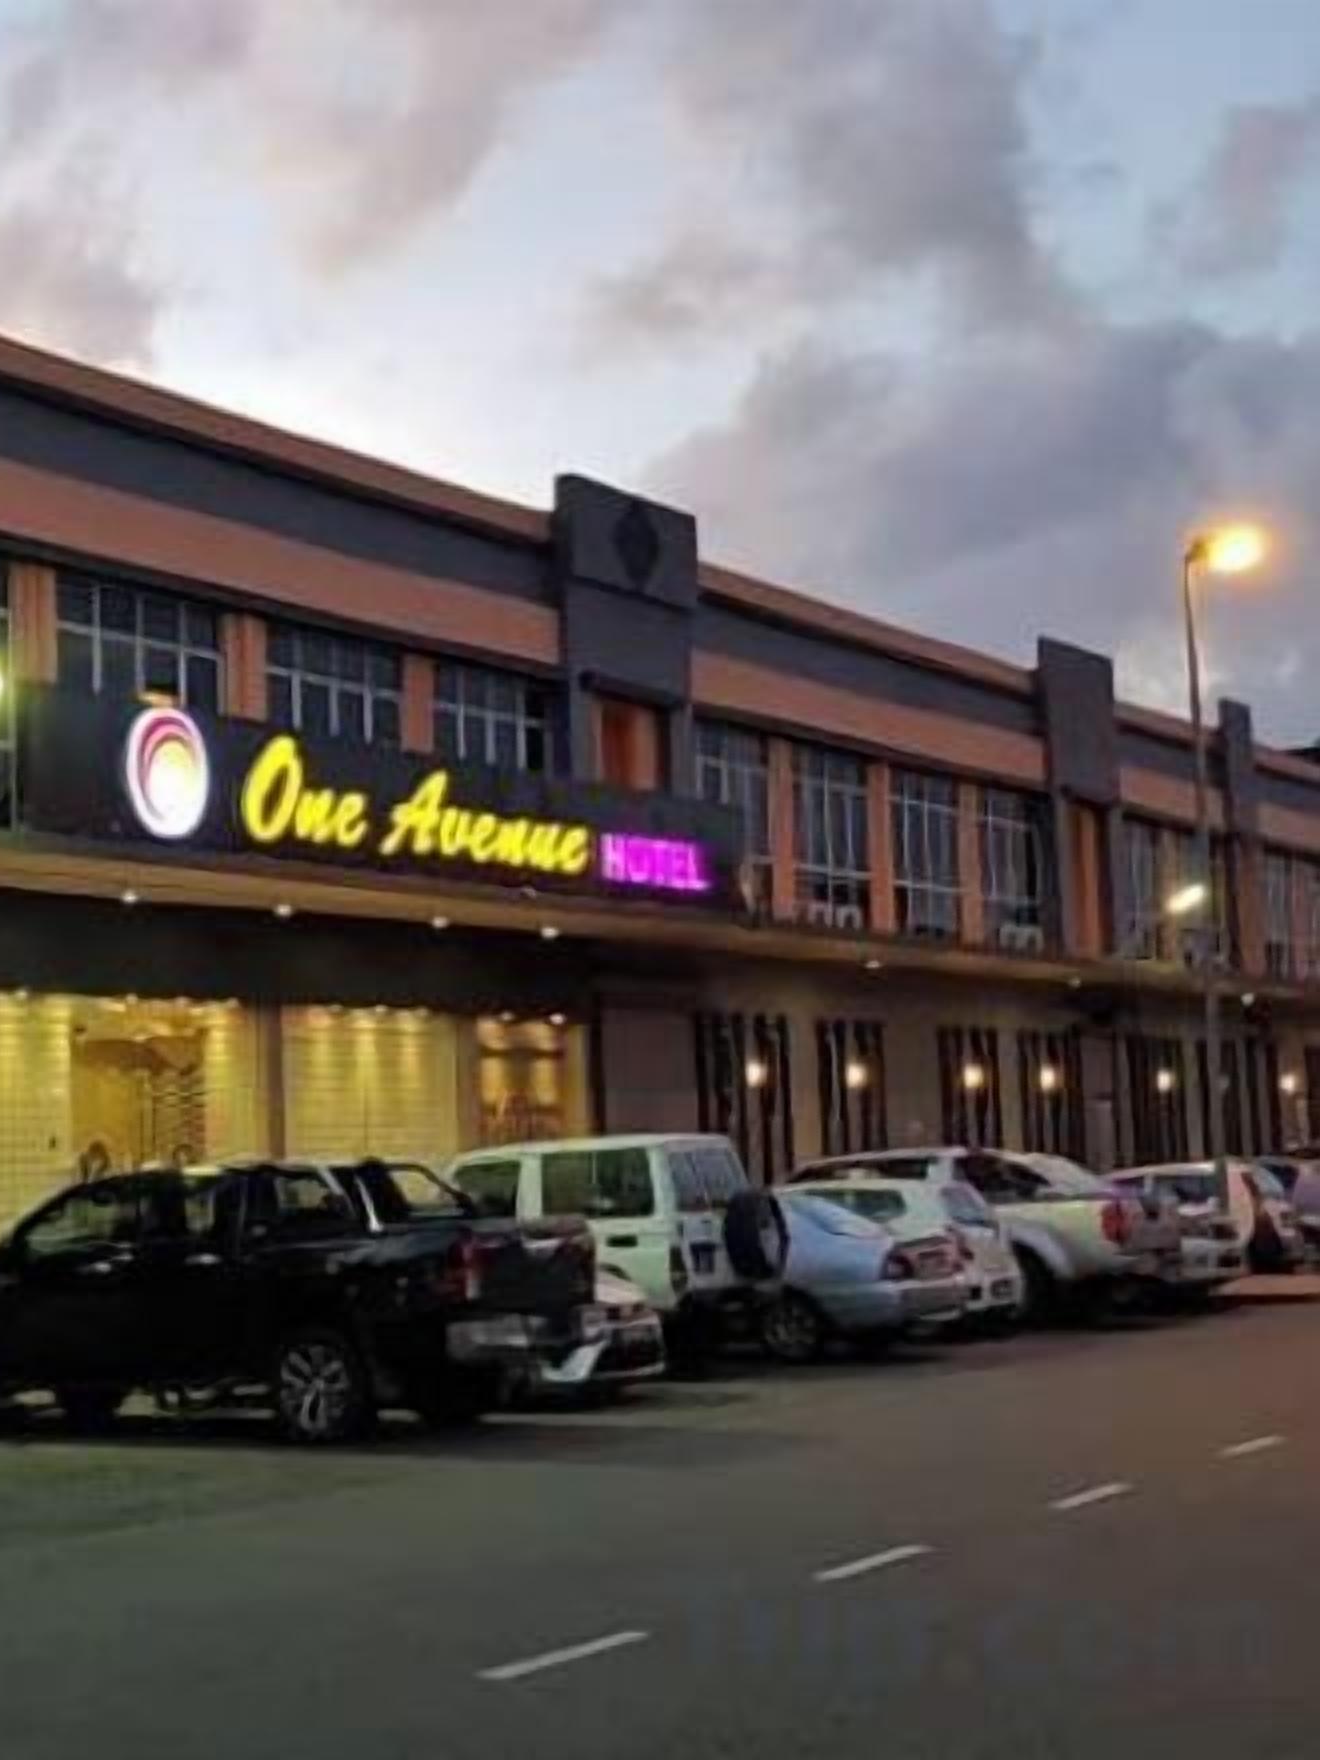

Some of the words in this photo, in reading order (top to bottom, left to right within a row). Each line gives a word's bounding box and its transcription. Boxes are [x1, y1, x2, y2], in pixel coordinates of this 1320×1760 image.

[241, 734, 369, 847] One
[379, 769, 589, 875] Avenue
[599, 833, 711, 891] HOTEL
